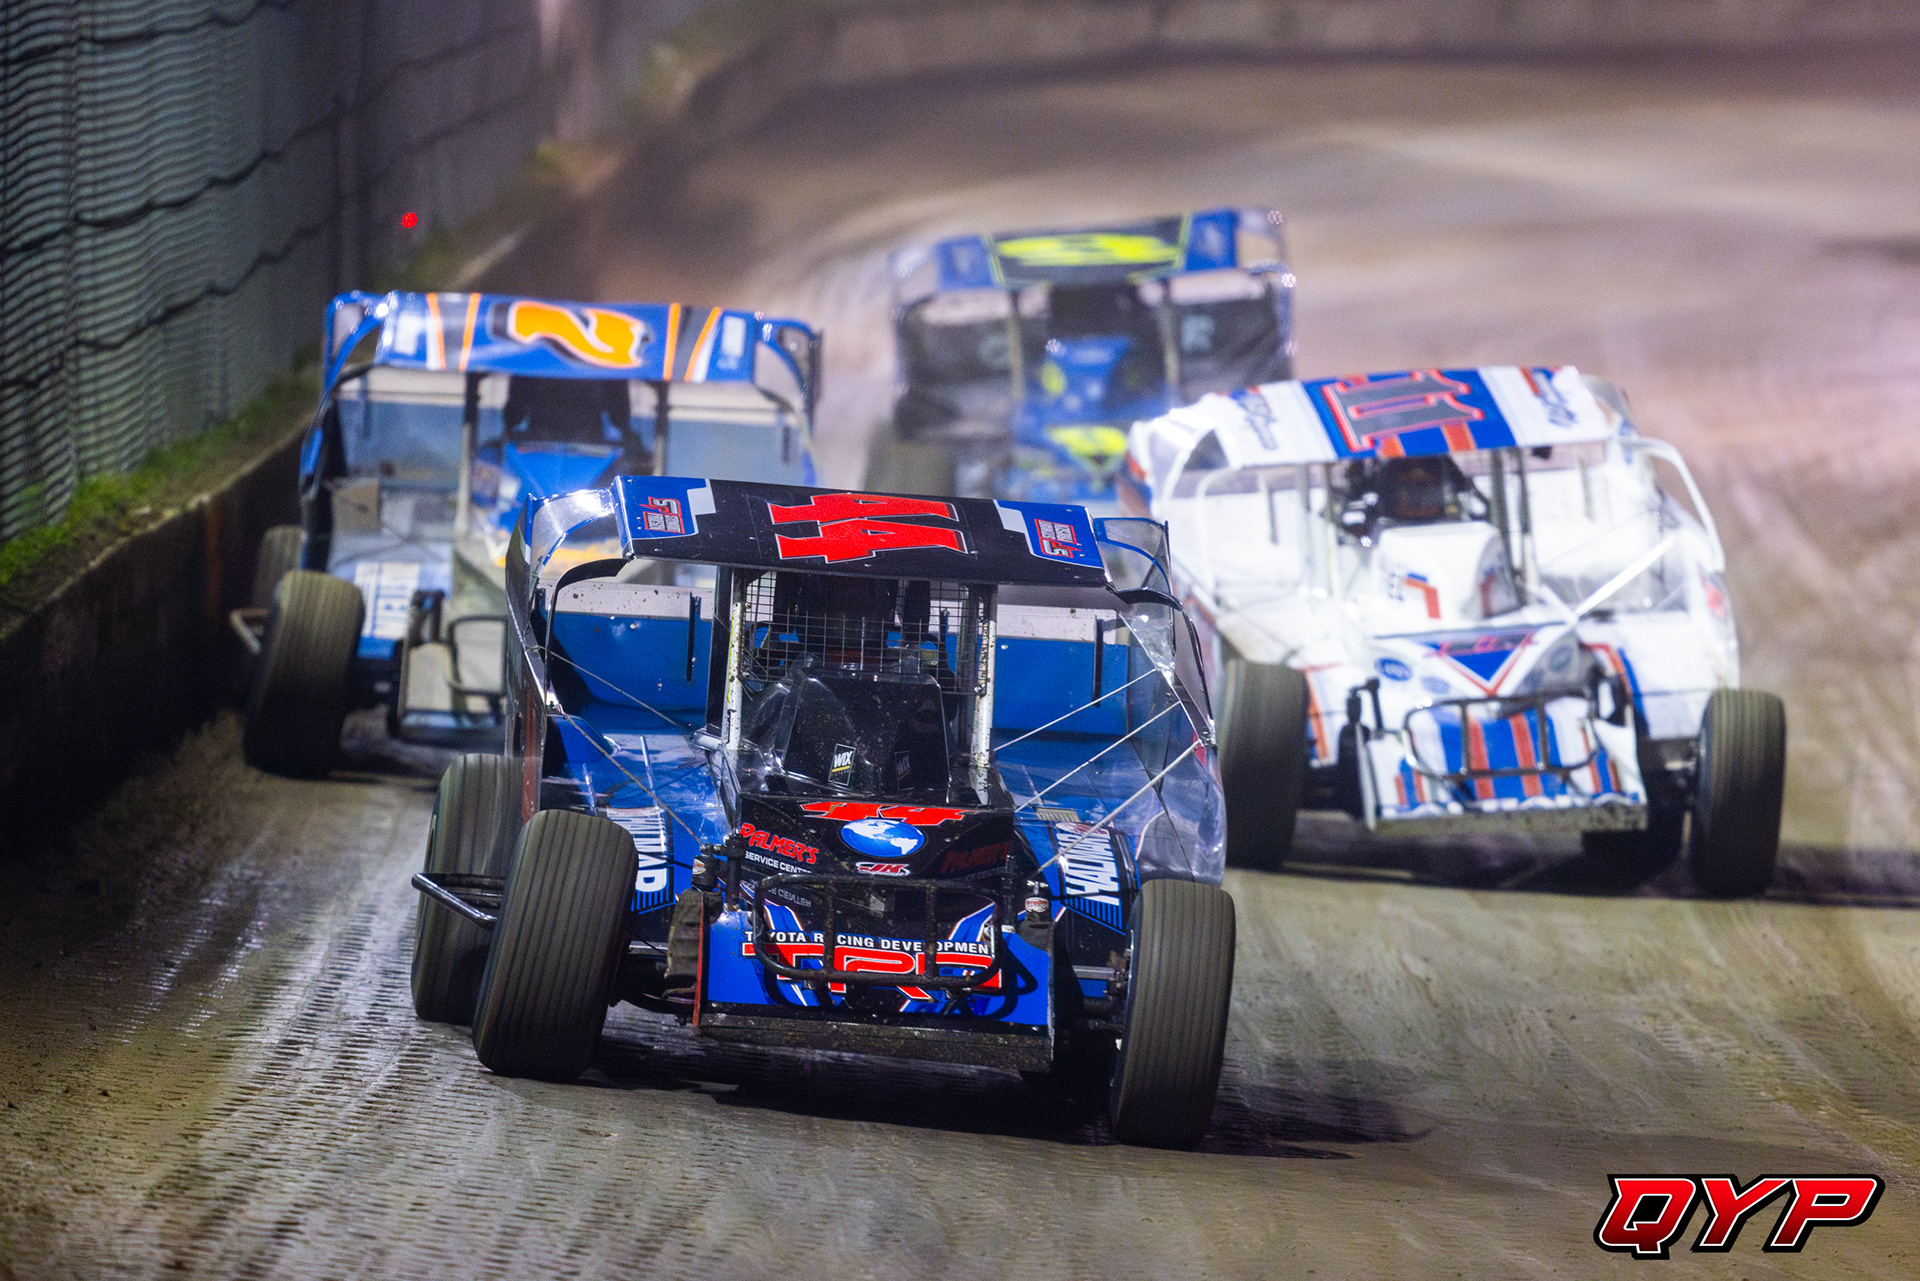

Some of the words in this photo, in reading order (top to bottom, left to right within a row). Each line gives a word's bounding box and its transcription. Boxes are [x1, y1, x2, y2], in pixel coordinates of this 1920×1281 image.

[1321, 368, 1484, 452] 11
[767, 493, 967, 563] 44
[834, 751, 853, 768] WIX
[740, 822, 819, 864] PALMER'S
[744, 850, 779, 869] SERVICE
[779, 861, 812, 873] CENT
[744, 930, 807, 943] TYOTA
[813, 932, 875, 948] RCING
